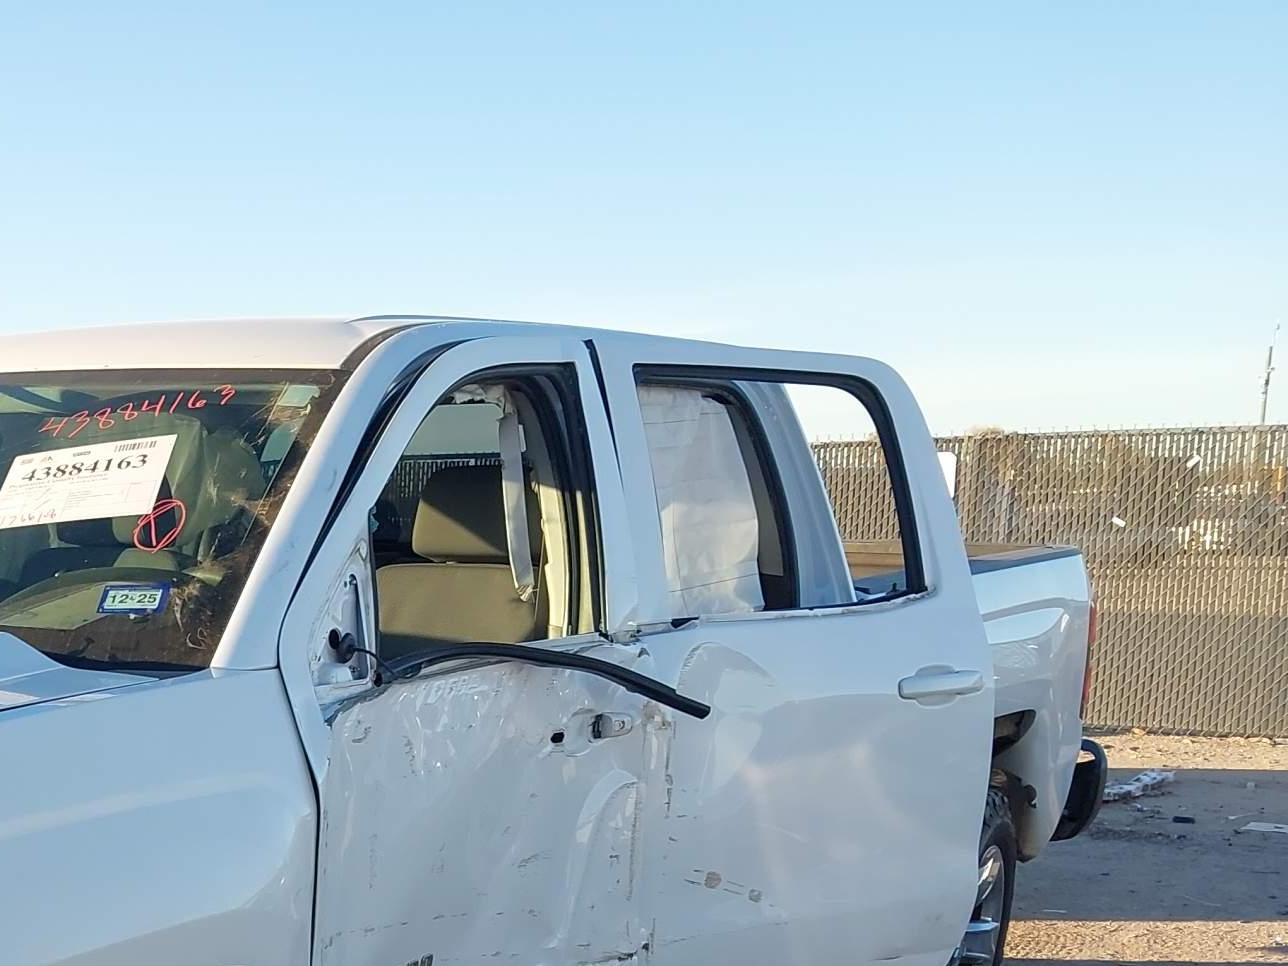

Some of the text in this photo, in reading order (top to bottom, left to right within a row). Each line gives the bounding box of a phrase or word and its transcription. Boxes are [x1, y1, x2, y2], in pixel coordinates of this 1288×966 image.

[38, 384, 237, 438] 43884163
[21, 454, 149, 482] 43884163
[109, 593, 158, 604] 12 25
